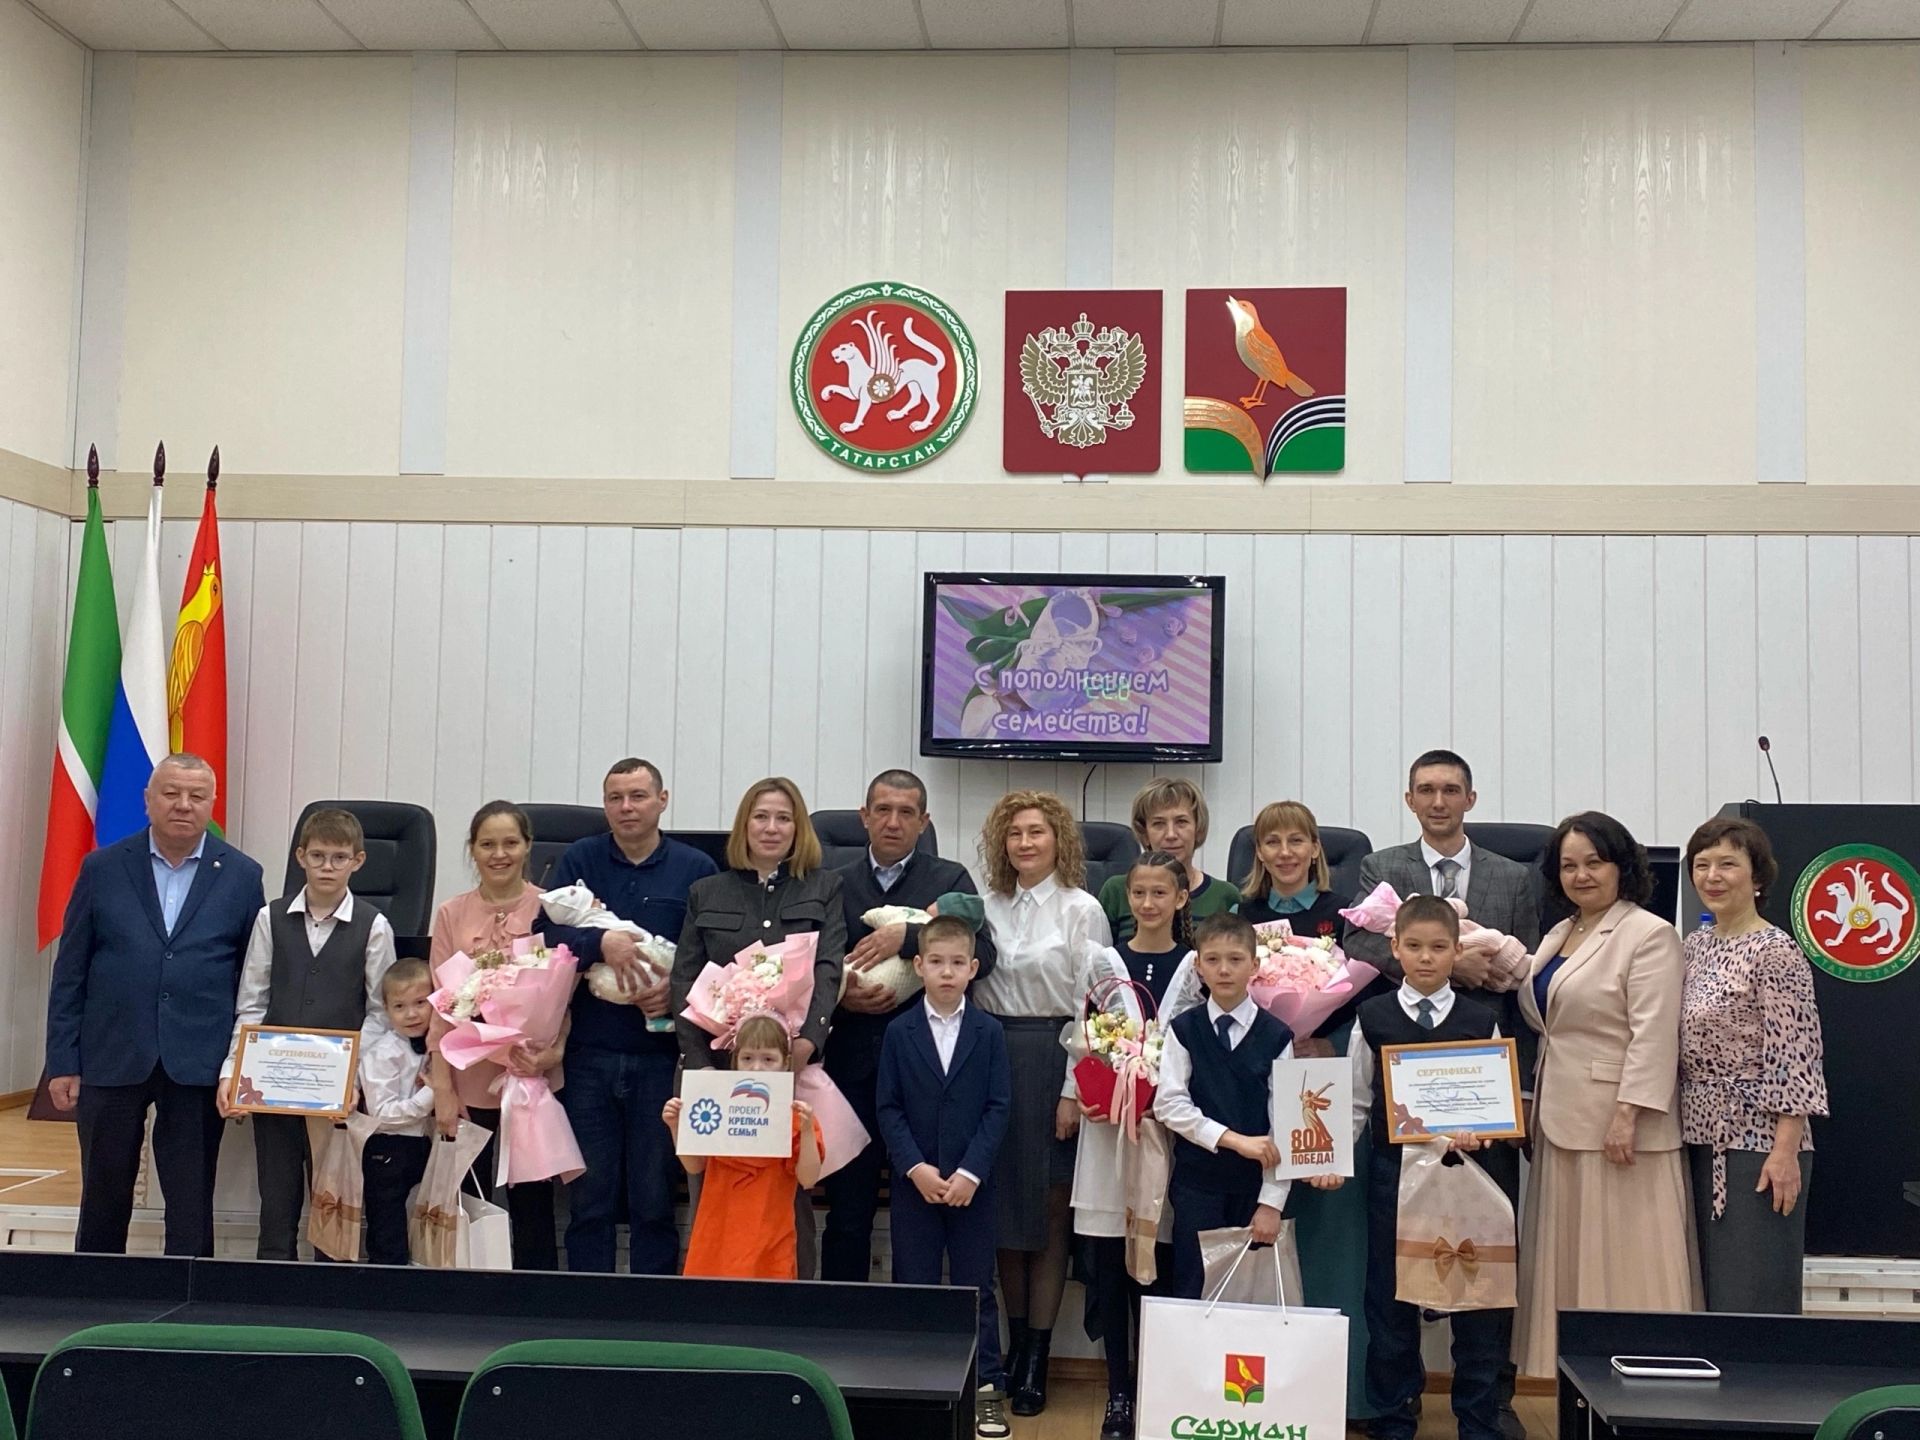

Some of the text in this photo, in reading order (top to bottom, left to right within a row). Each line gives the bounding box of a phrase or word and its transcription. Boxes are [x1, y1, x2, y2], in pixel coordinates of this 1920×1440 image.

[830, 441, 937, 468] ТАТАРСТАН
[974, 664, 1169, 692] С пополнением
[993, 705, 1149, 734] семейства!
[1821, 958, 1899, 980] ТАТАРСТАН
[268, 1048, 329, 1060] СЕРТИФИКАТ
[1416, 1065, 1483, 1077] СЕРТИФИКАТ
[728, 1105, 761, 1115] ПРОЕКТ
[728, 1116, 769, 1126] КРЕПКАЯ
[727, 1127, 758, 1137] СЕМЬЯ
[1291, 1128, 1314, 1149] 80
[1291, 1152, 1335, 1166] ПОБЕДА!
